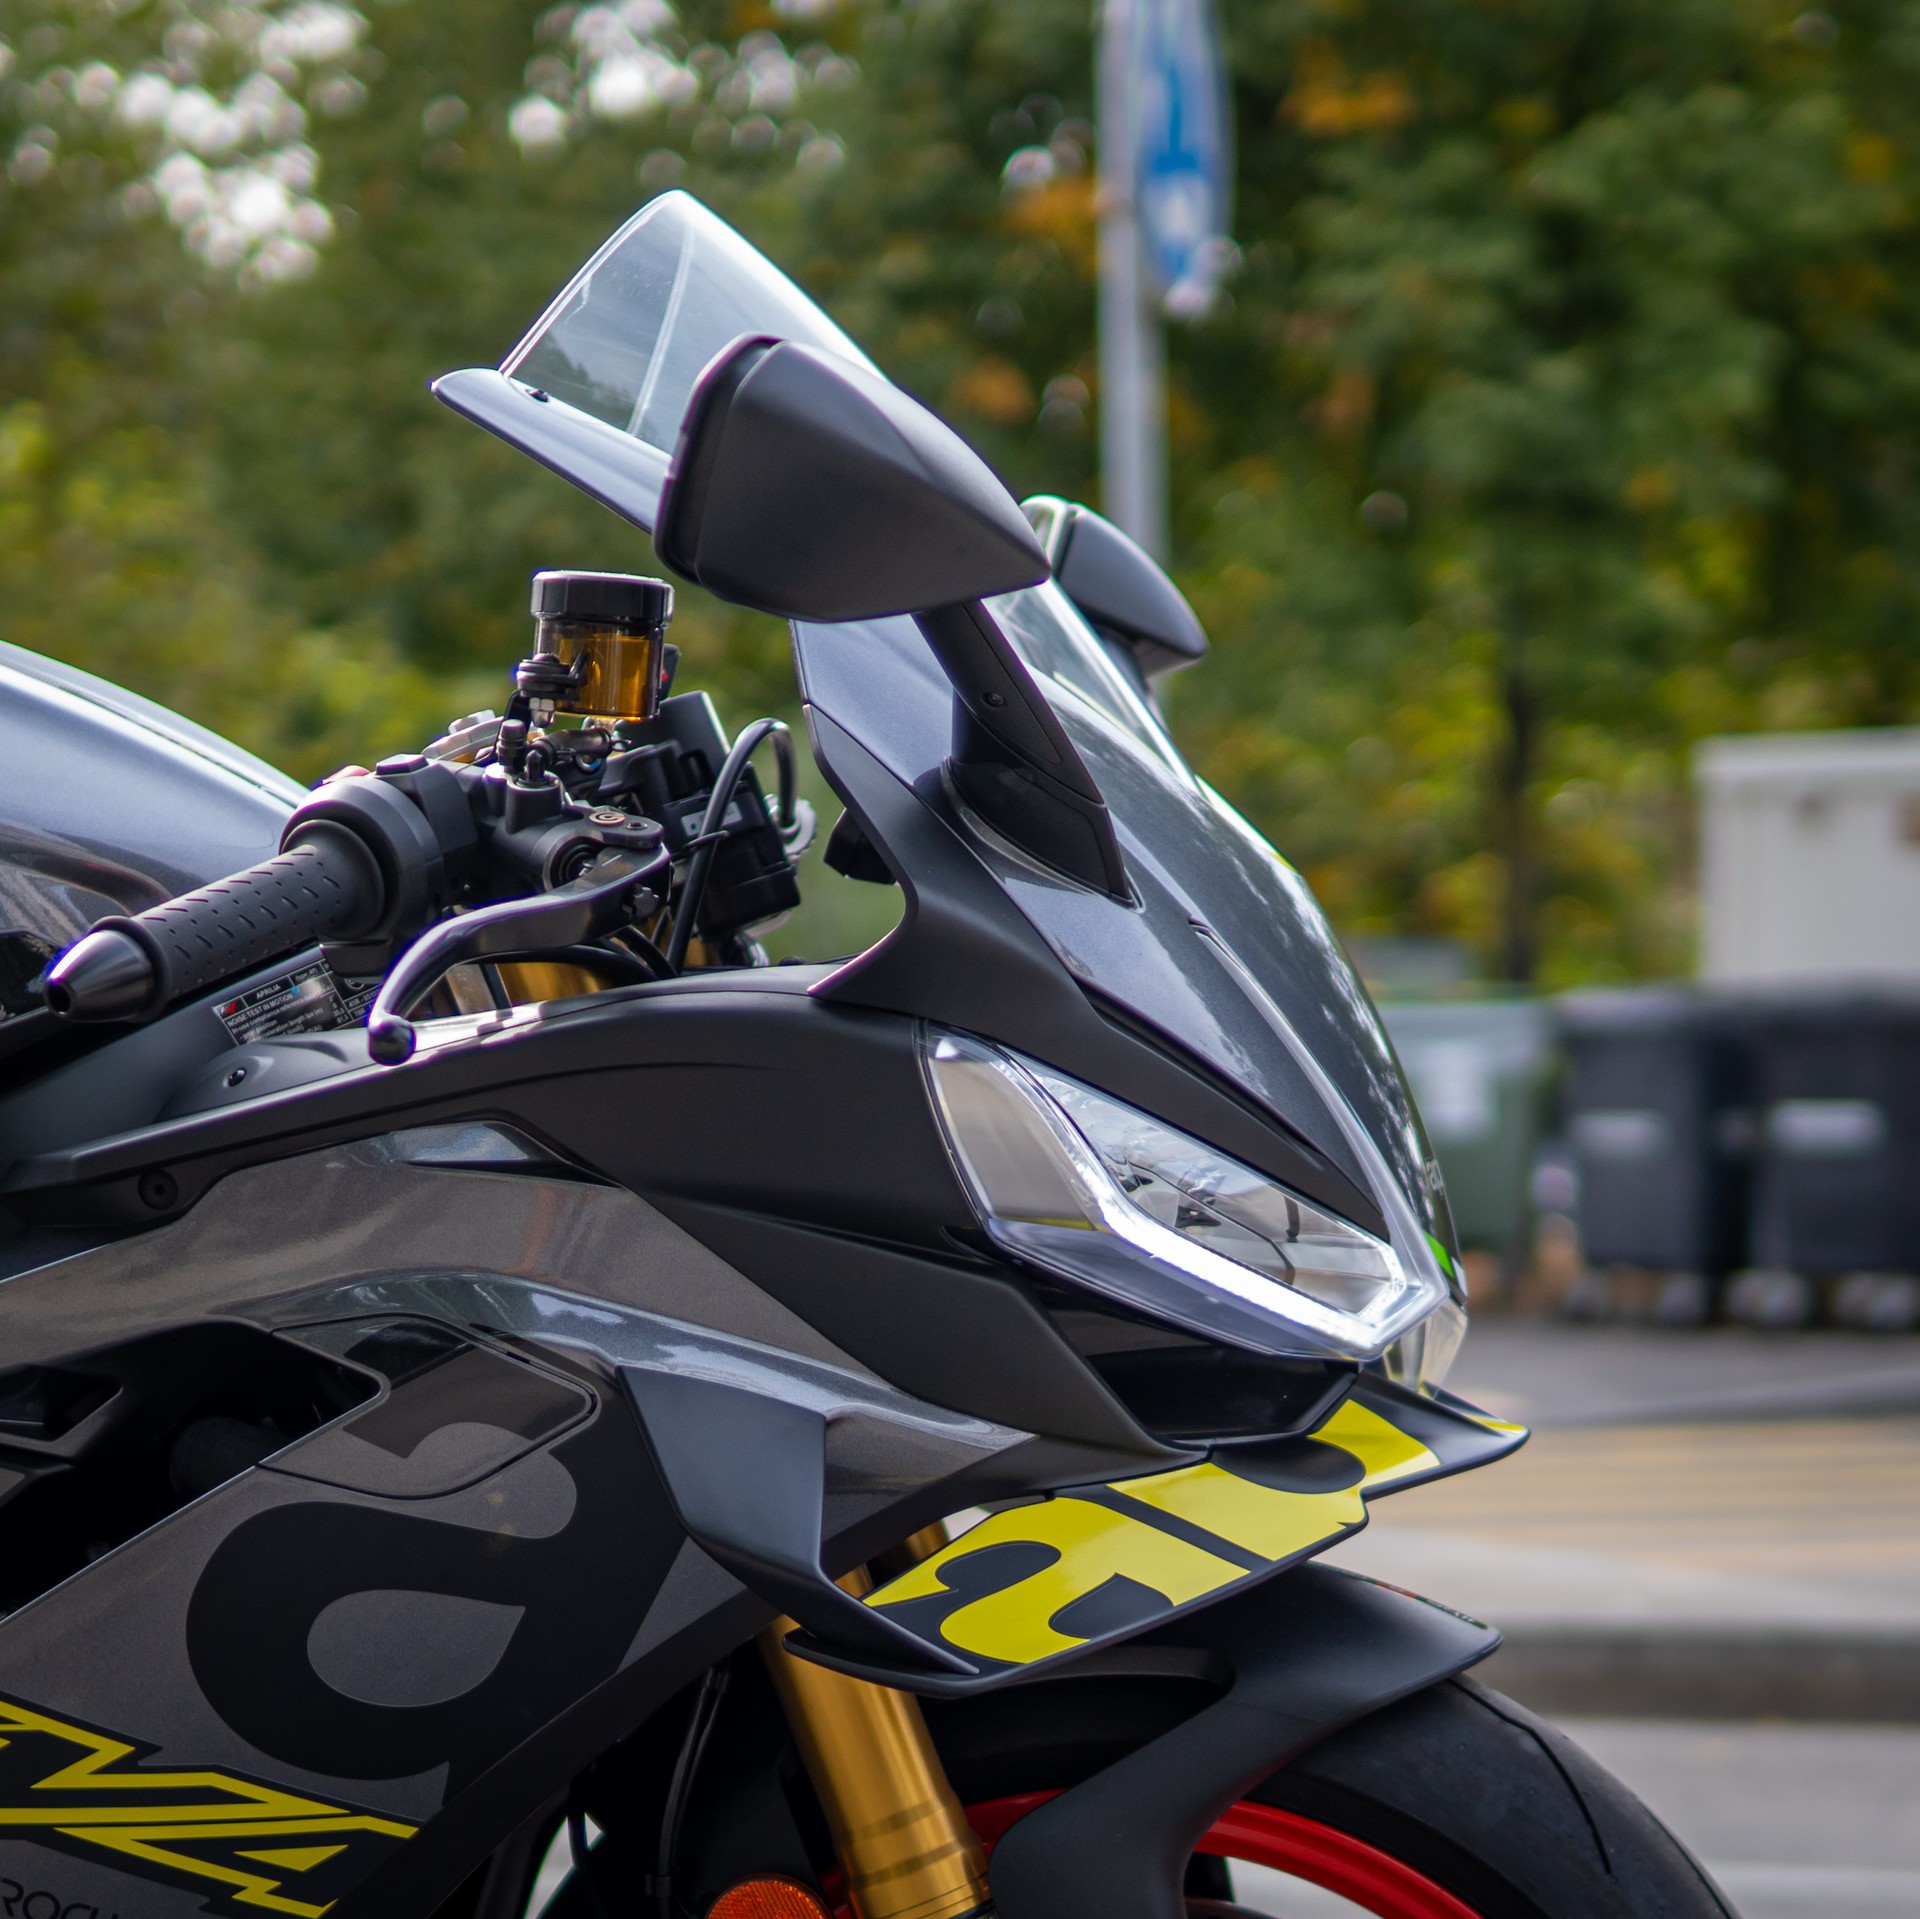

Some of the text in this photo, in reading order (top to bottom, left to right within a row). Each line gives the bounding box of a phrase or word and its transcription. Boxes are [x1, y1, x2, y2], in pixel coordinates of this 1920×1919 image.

[256, 984, 281, 1000] APRILIA
[227, 1013, 247, 1027] NOISE
[246, 1006, 263, 1018] TEST
[269, 992, 294, 1009] MOTION
